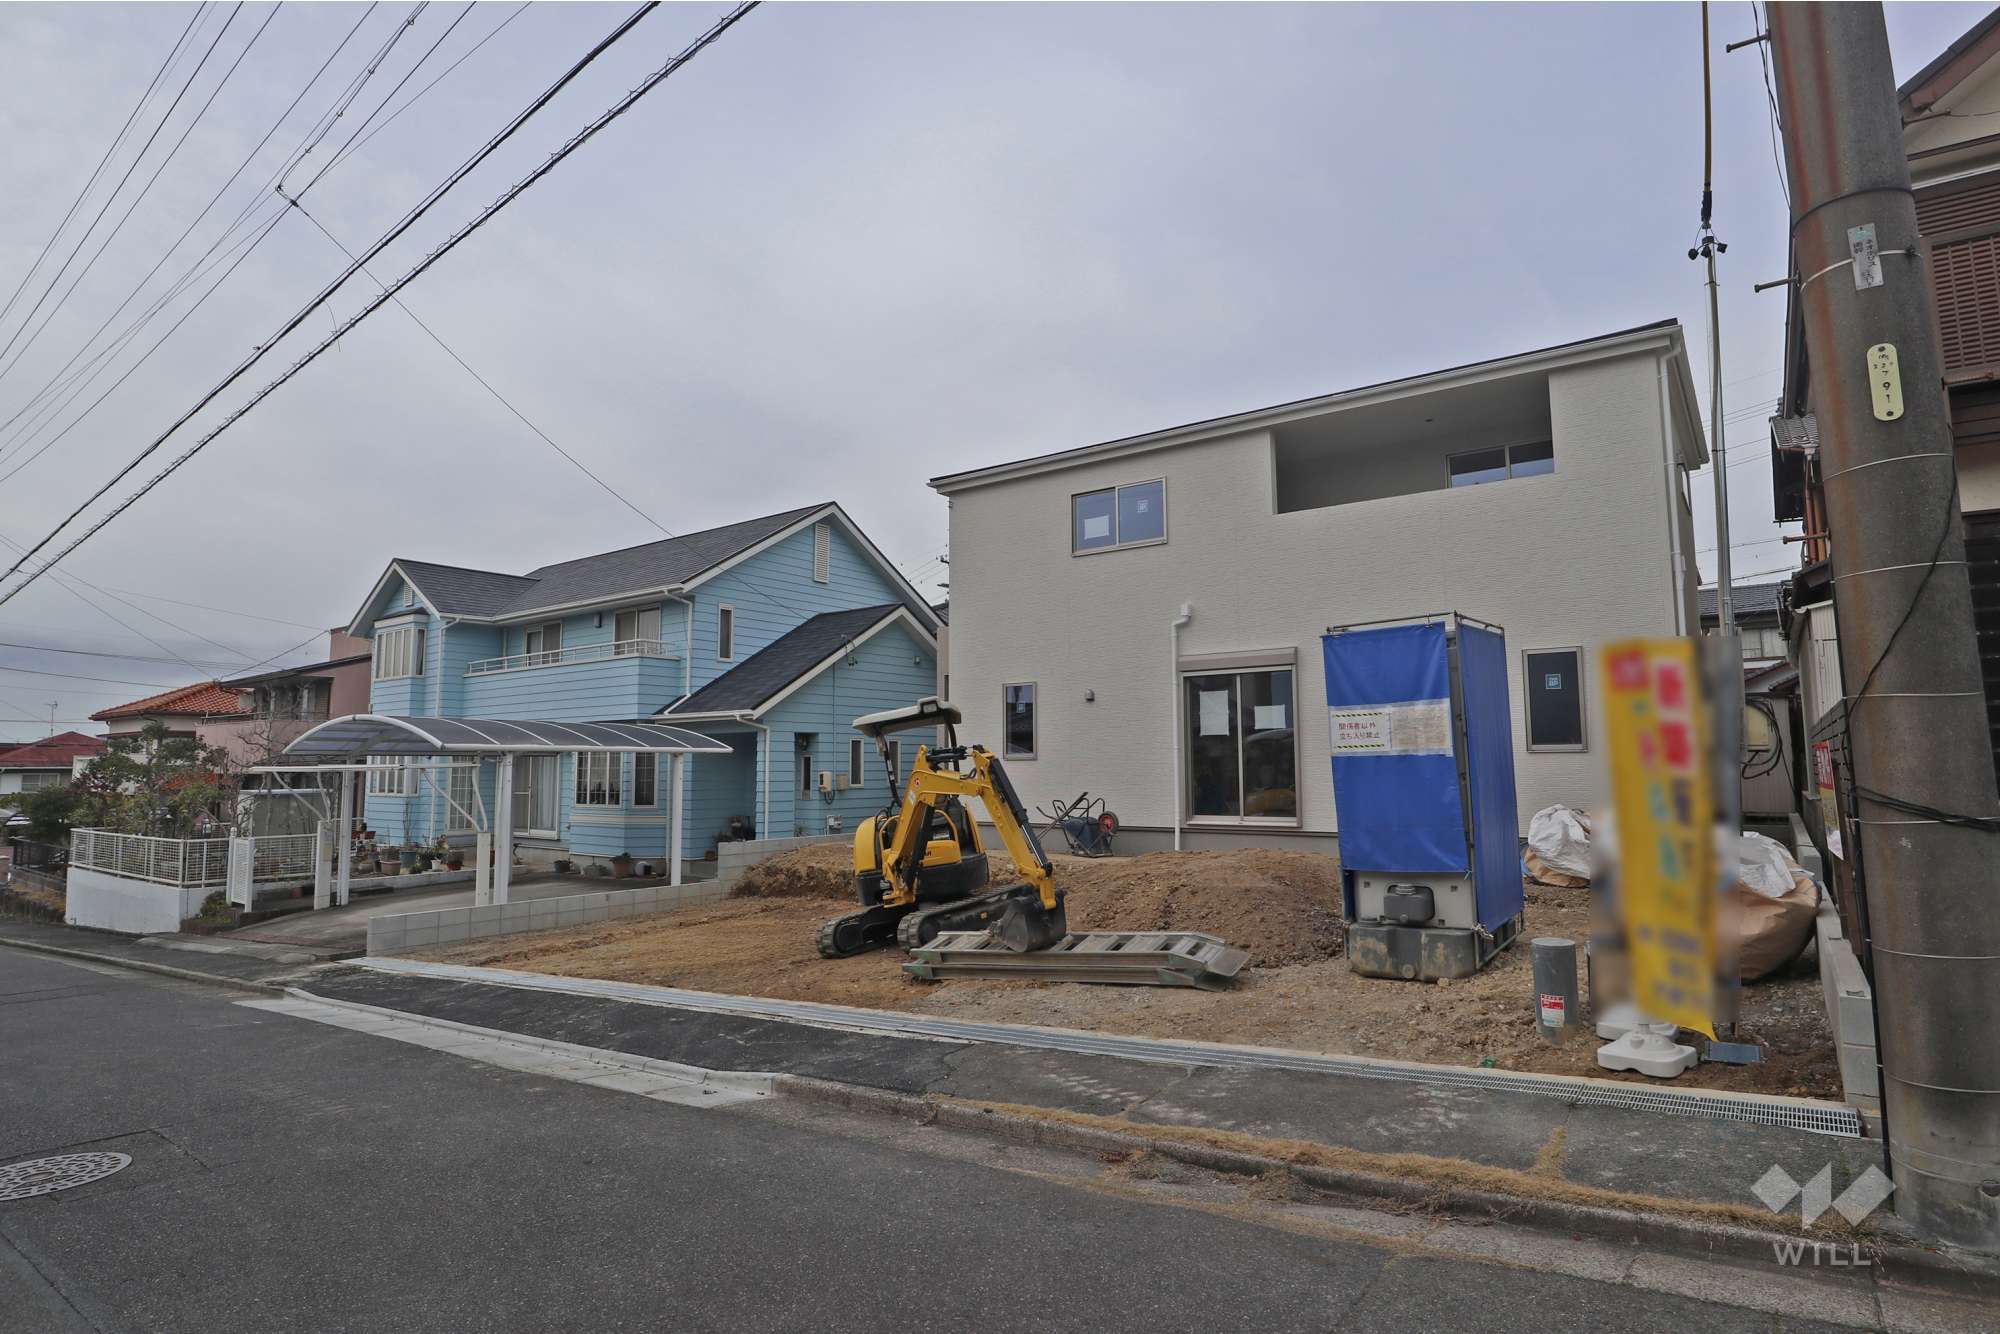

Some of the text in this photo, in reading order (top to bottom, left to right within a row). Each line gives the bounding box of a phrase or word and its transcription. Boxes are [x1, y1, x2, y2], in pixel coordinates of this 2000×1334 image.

[1339, 721, 1376, 730] 関係者以外
[1339, 731, 1380, 740] 立ち入り禁止
